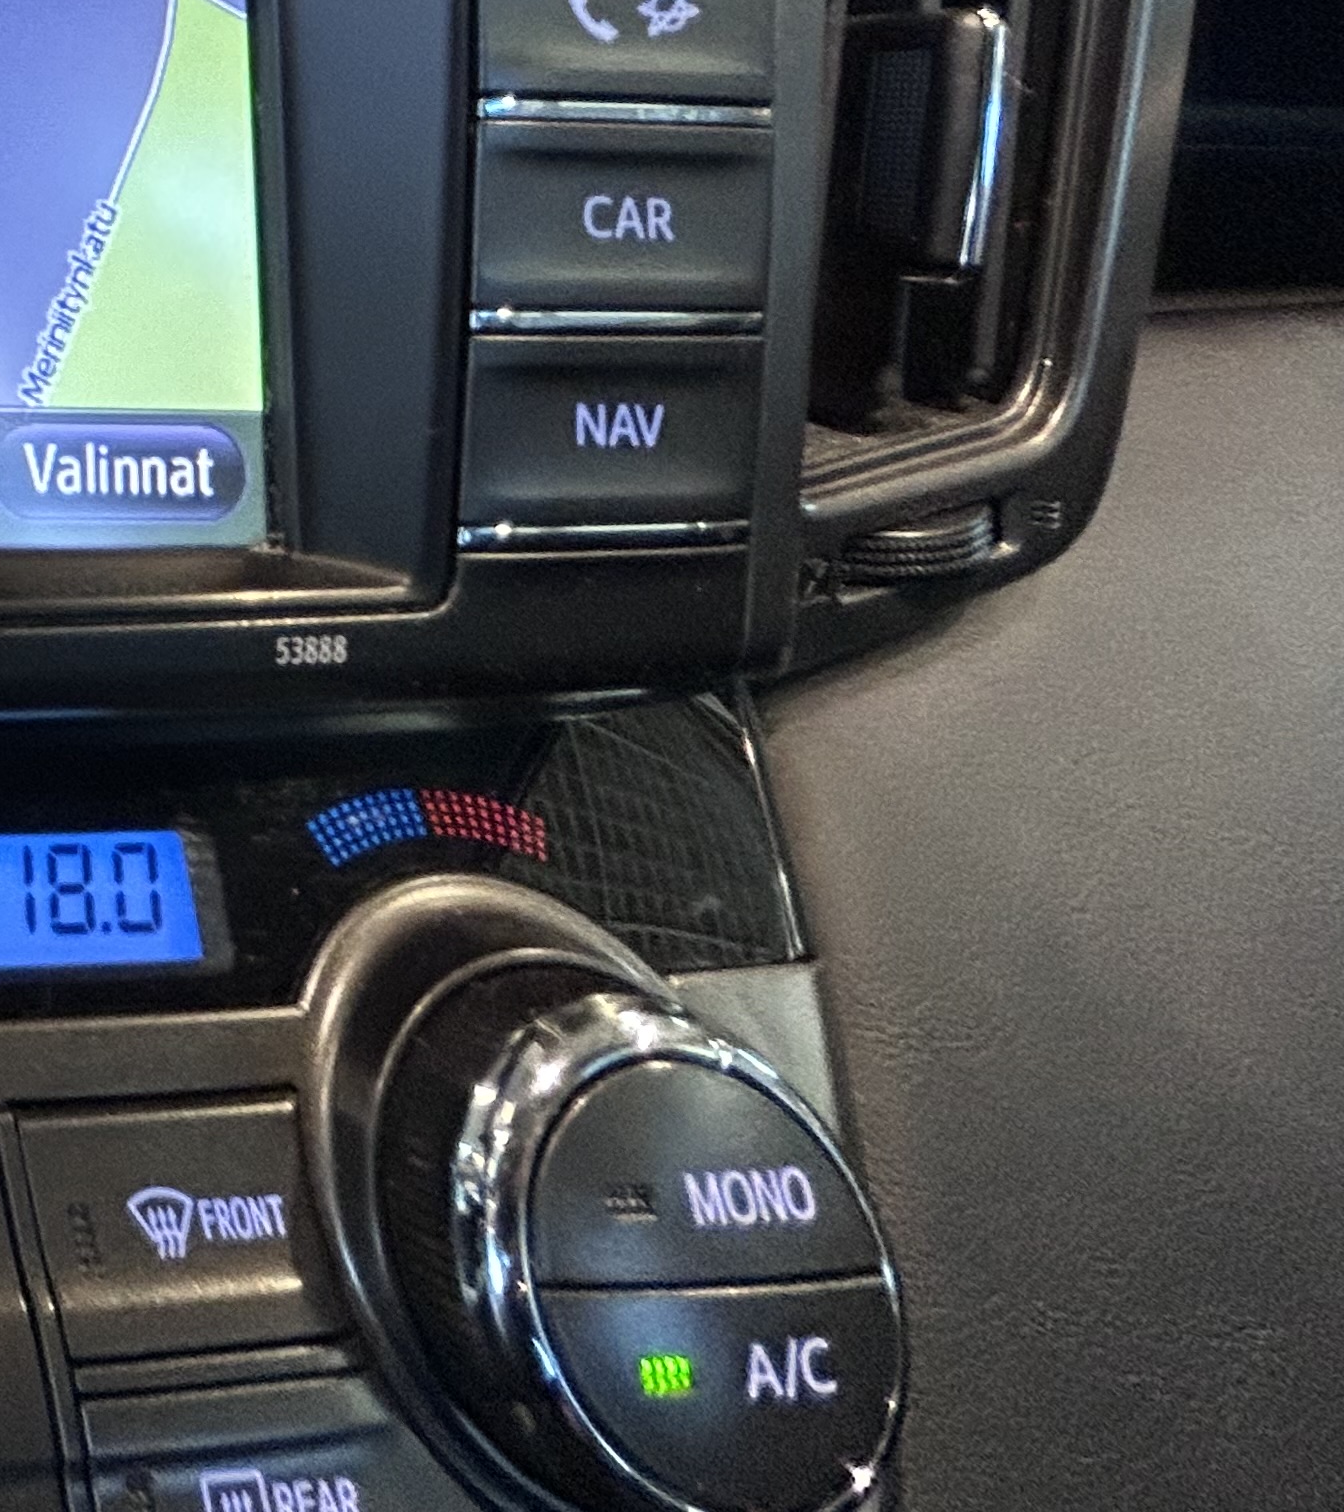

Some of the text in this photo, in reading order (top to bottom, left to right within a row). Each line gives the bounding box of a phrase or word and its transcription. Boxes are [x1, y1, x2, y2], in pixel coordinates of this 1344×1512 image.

[582, 194, 675, 242] CAR
[574, 402, 666, 449] NAV
[22, 441, 215, 498] Valinnat
[20, 840, 163, 937] 18.0
[197, 1193, 287, 1241] FRONT
[683, 1166, 818, 1228] MONO
[745, 1337, 839, 1401] A/C
